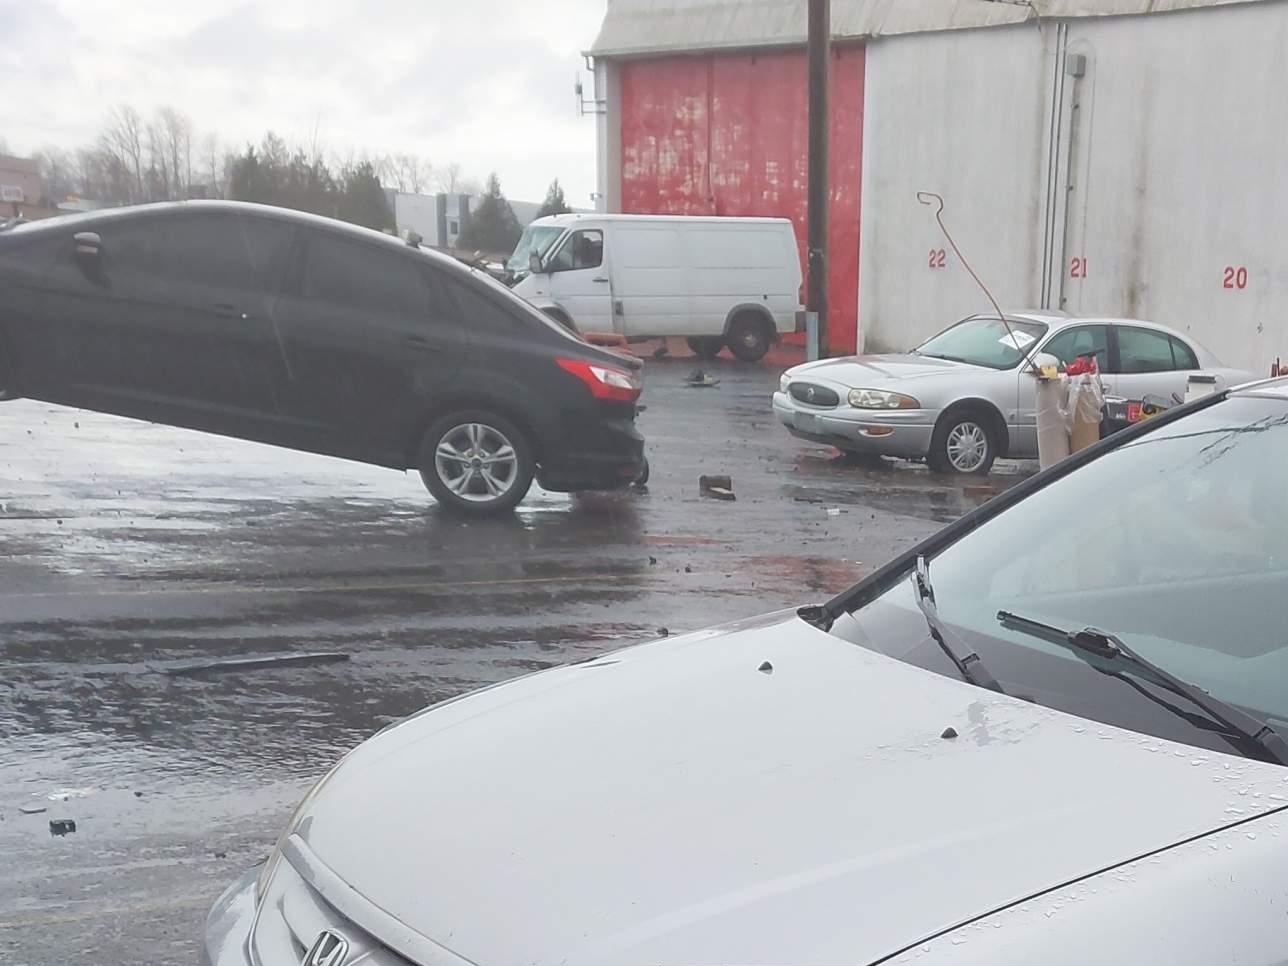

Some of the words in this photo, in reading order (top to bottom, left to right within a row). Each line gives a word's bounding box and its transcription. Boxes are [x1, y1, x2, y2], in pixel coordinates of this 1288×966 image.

[927, 249, 946, 269] 22
[1070, 257, 1089, 279] 21
[1223, 266, 1248, 289] 20
